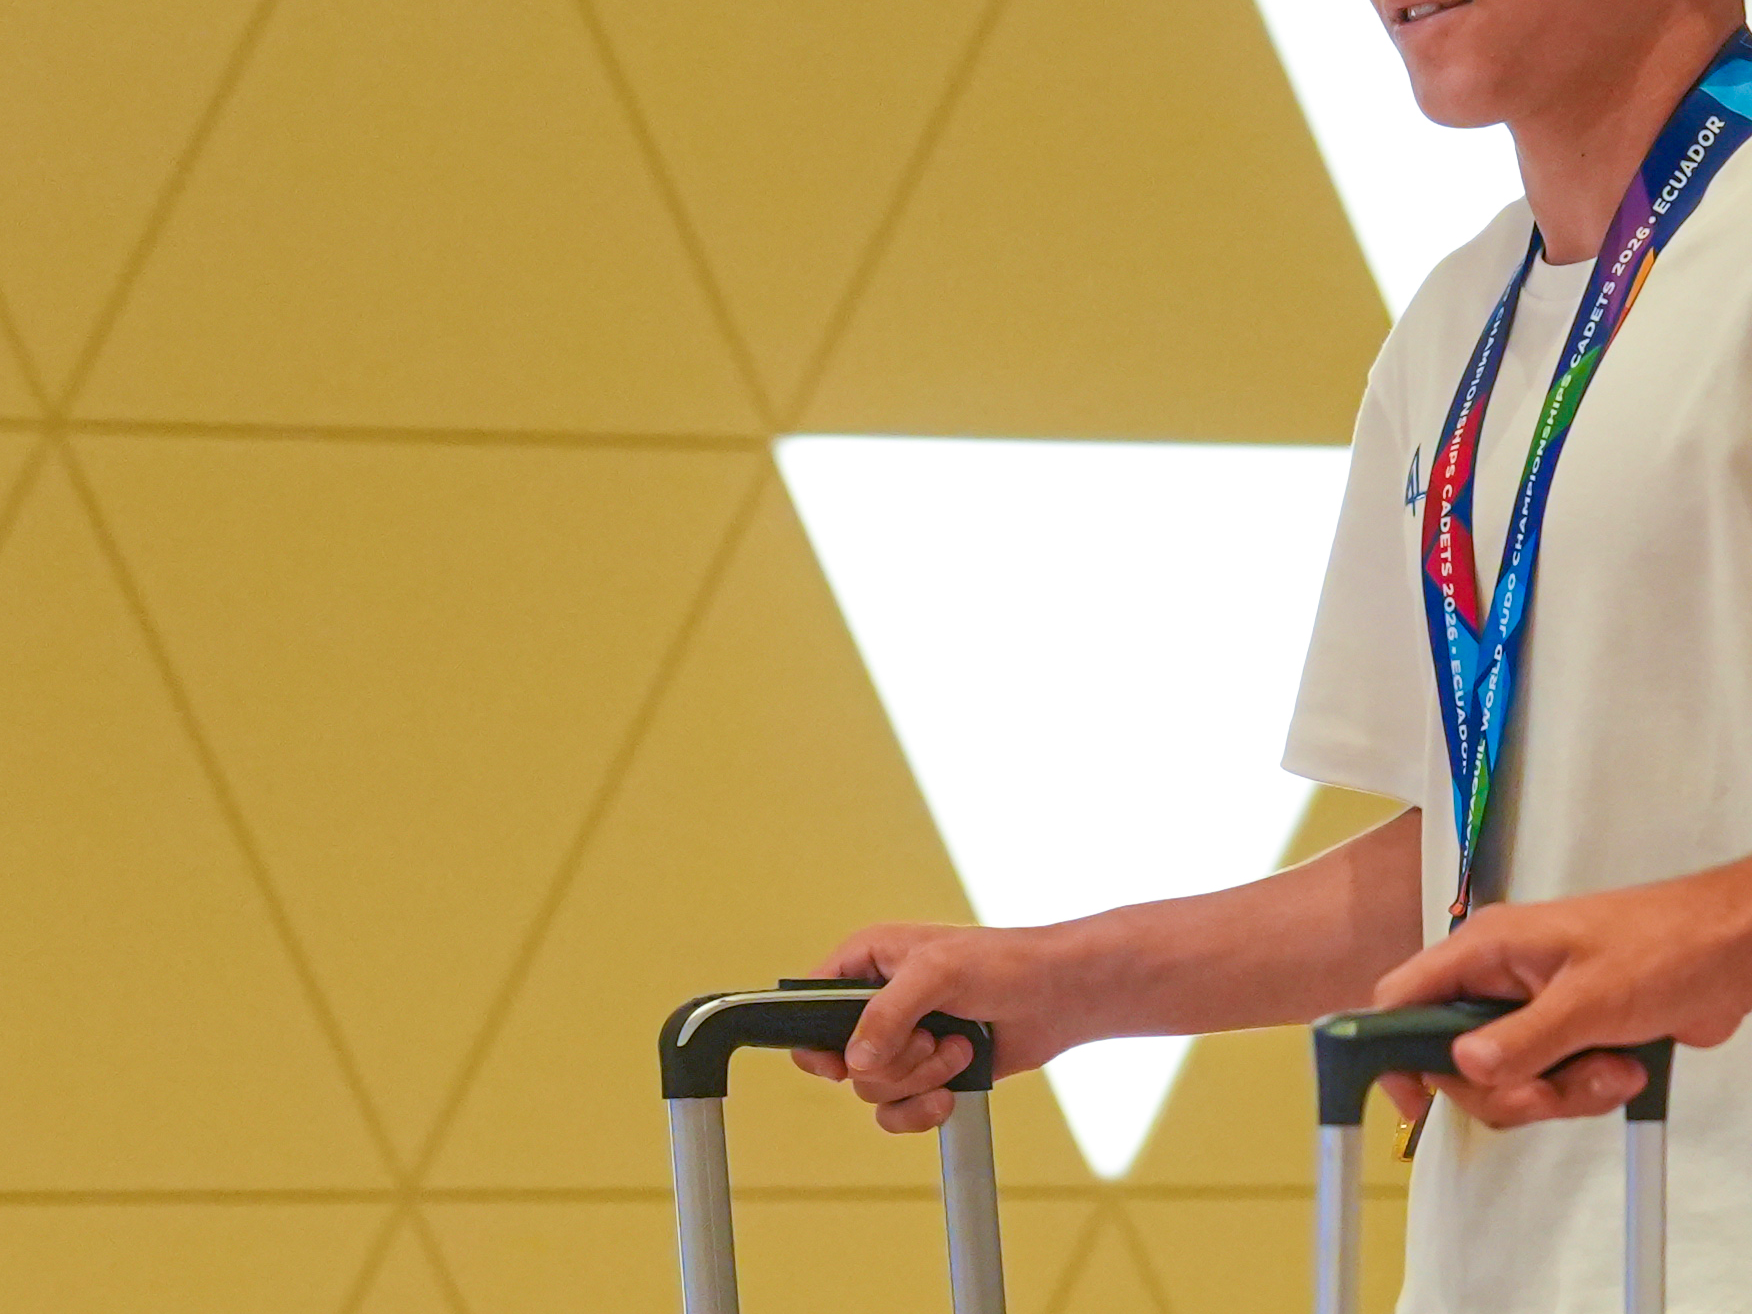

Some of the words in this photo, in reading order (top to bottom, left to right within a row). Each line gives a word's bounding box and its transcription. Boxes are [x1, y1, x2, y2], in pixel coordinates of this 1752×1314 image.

[1445, 306, 1505, 479] CHAMPIONSHIPS
[1480, 644, 1503, 732] WORLD
[1499, 573, 1517, 639] JUDO
[1512, 374, 1572, 566] CHAMPIONSHIPS
[1570, 281, 1615, 368] CADETS
[1612, 226, 1651, 276] 2026
[1653, 115, 1725, 215] ECUADOR
[1439, 484, 1454, 578] CADETS
[1442, 583, 1458, 641] 2026
